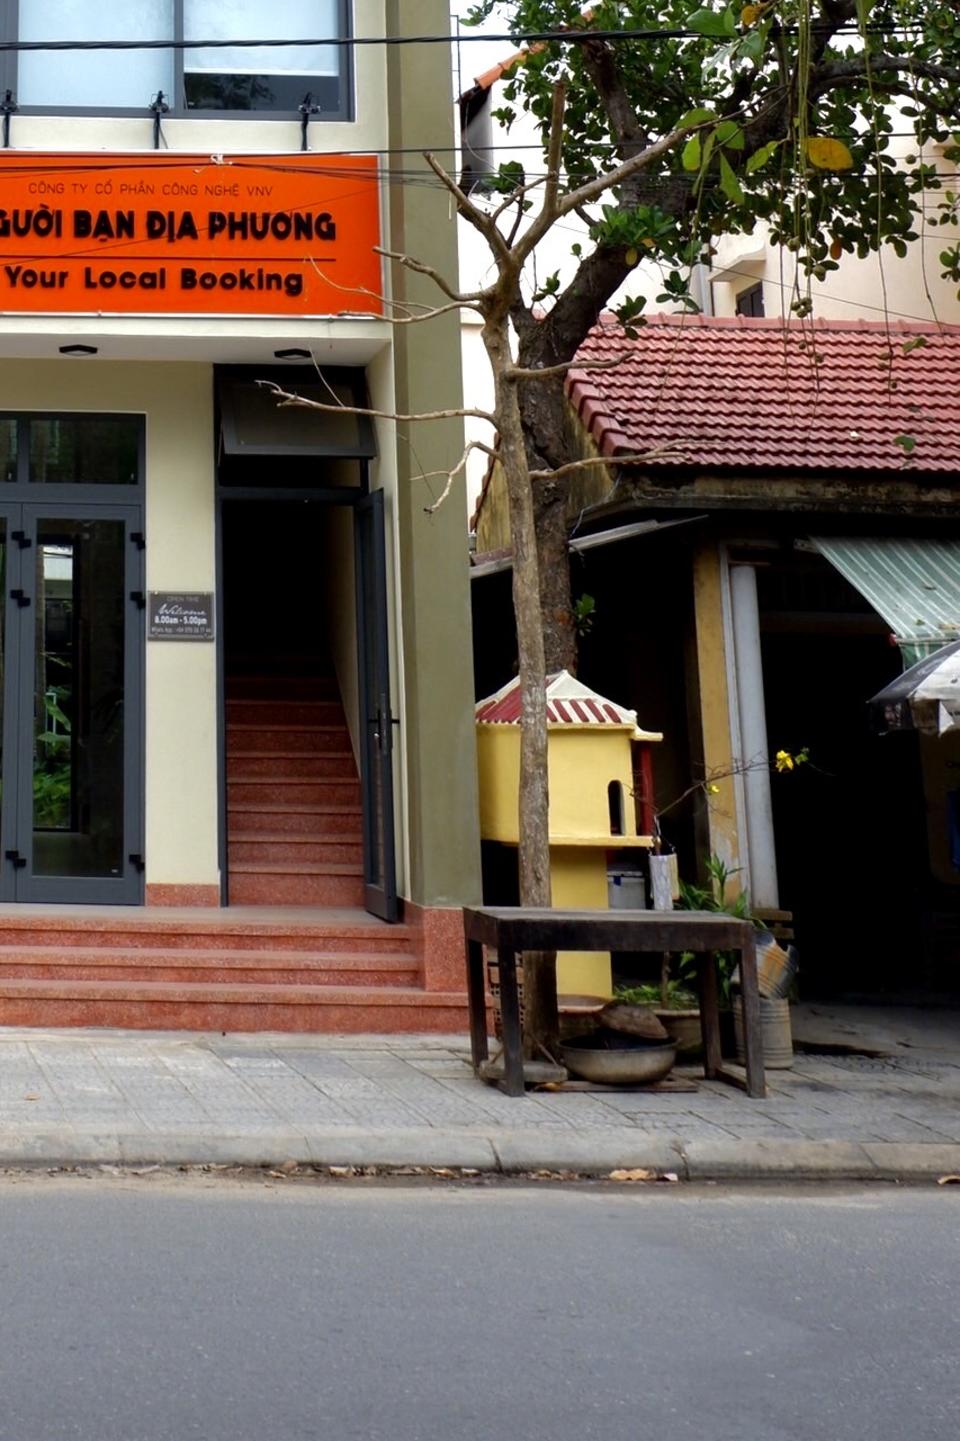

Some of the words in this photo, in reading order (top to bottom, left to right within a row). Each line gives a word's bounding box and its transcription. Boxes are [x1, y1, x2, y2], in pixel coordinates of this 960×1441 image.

[28, 180, 65, 194] CÔNG
[71, 182, 88, 194] TY
[162, 181, 198, 196] CÔNG
[247, 185, 273, 196] VNV
[73, 209, 135, 242] BẠN
[5, 265, 69, 289] Your
[85, 266, 166, 290] Local
[181, 268, 303, 296] Booking
